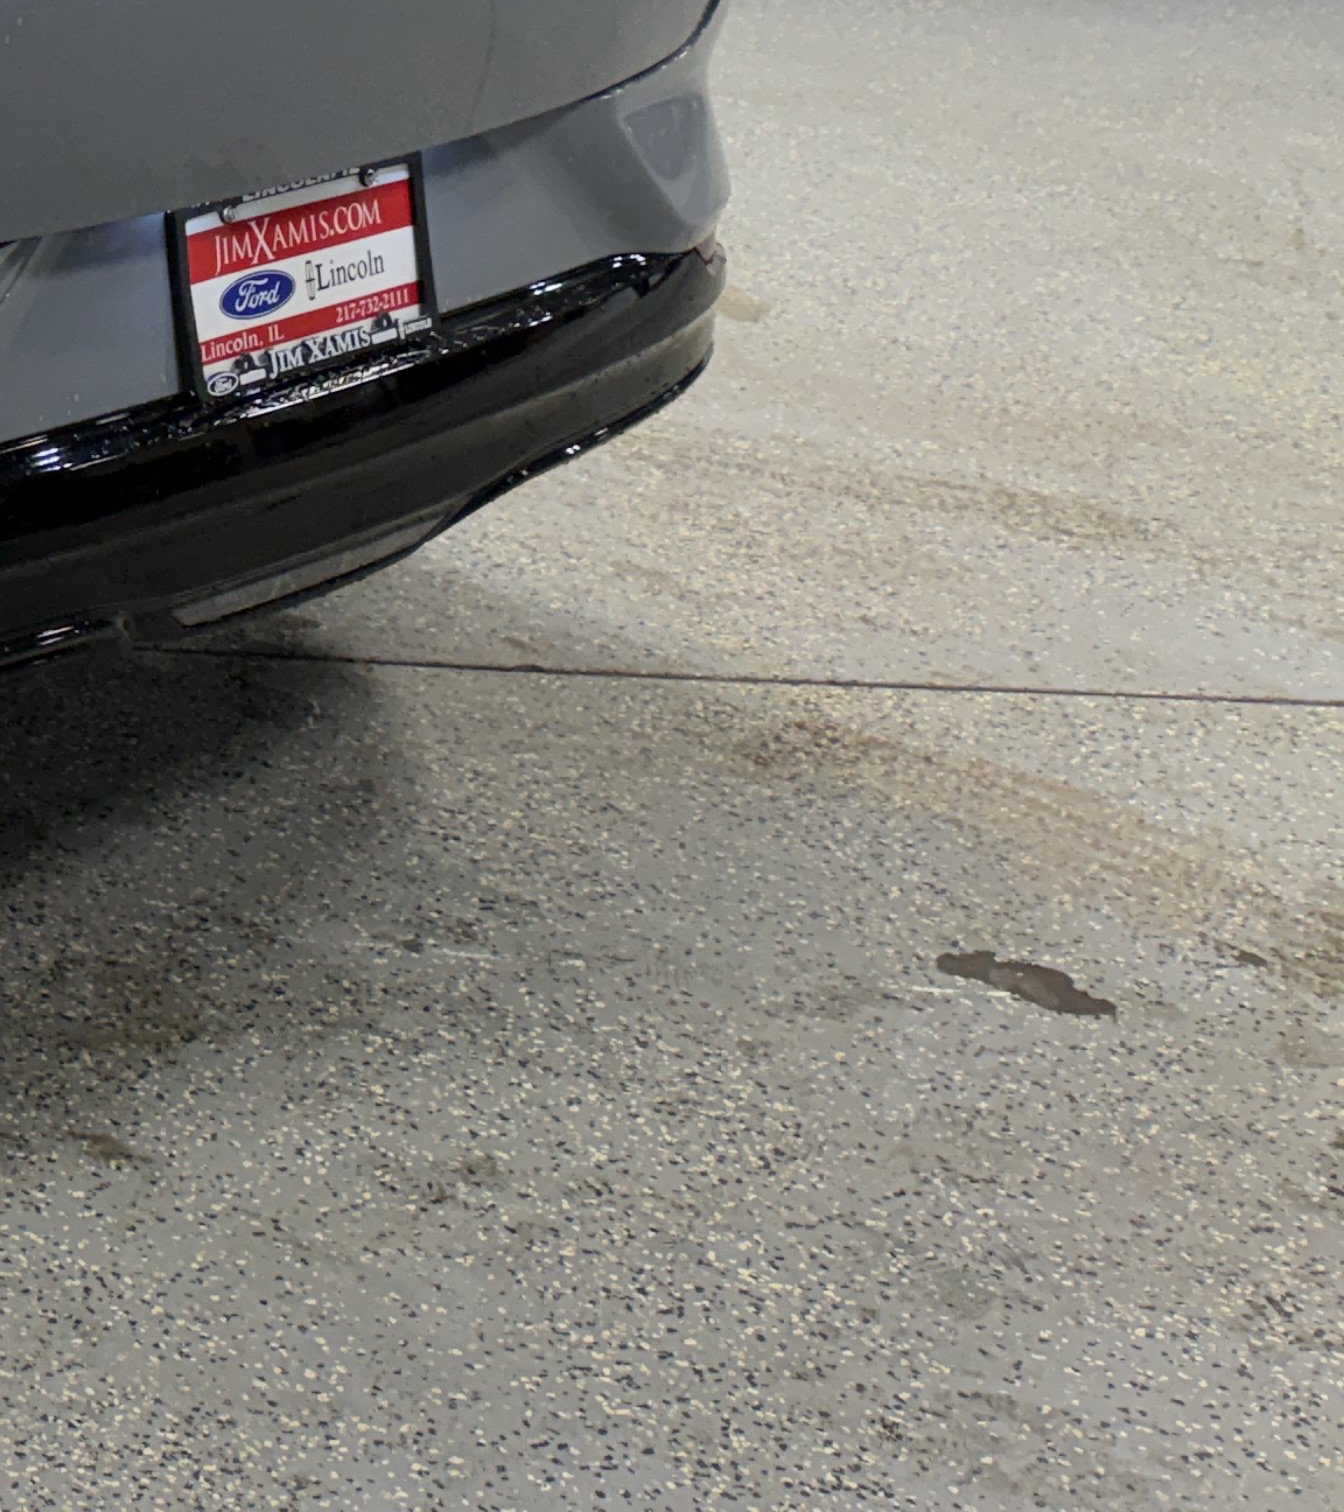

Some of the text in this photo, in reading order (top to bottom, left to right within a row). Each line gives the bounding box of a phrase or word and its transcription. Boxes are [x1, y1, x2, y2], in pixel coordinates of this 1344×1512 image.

[315, 250, 384, 292] Lincoln
[235, 277, 281, 312] Ford
[335, 288, 410, 324] 217-732-2111
[268, 324, 284, 342] IL
[269, 347, 304, 379] JIM
[307, 326, 372, 359] XAMIS
